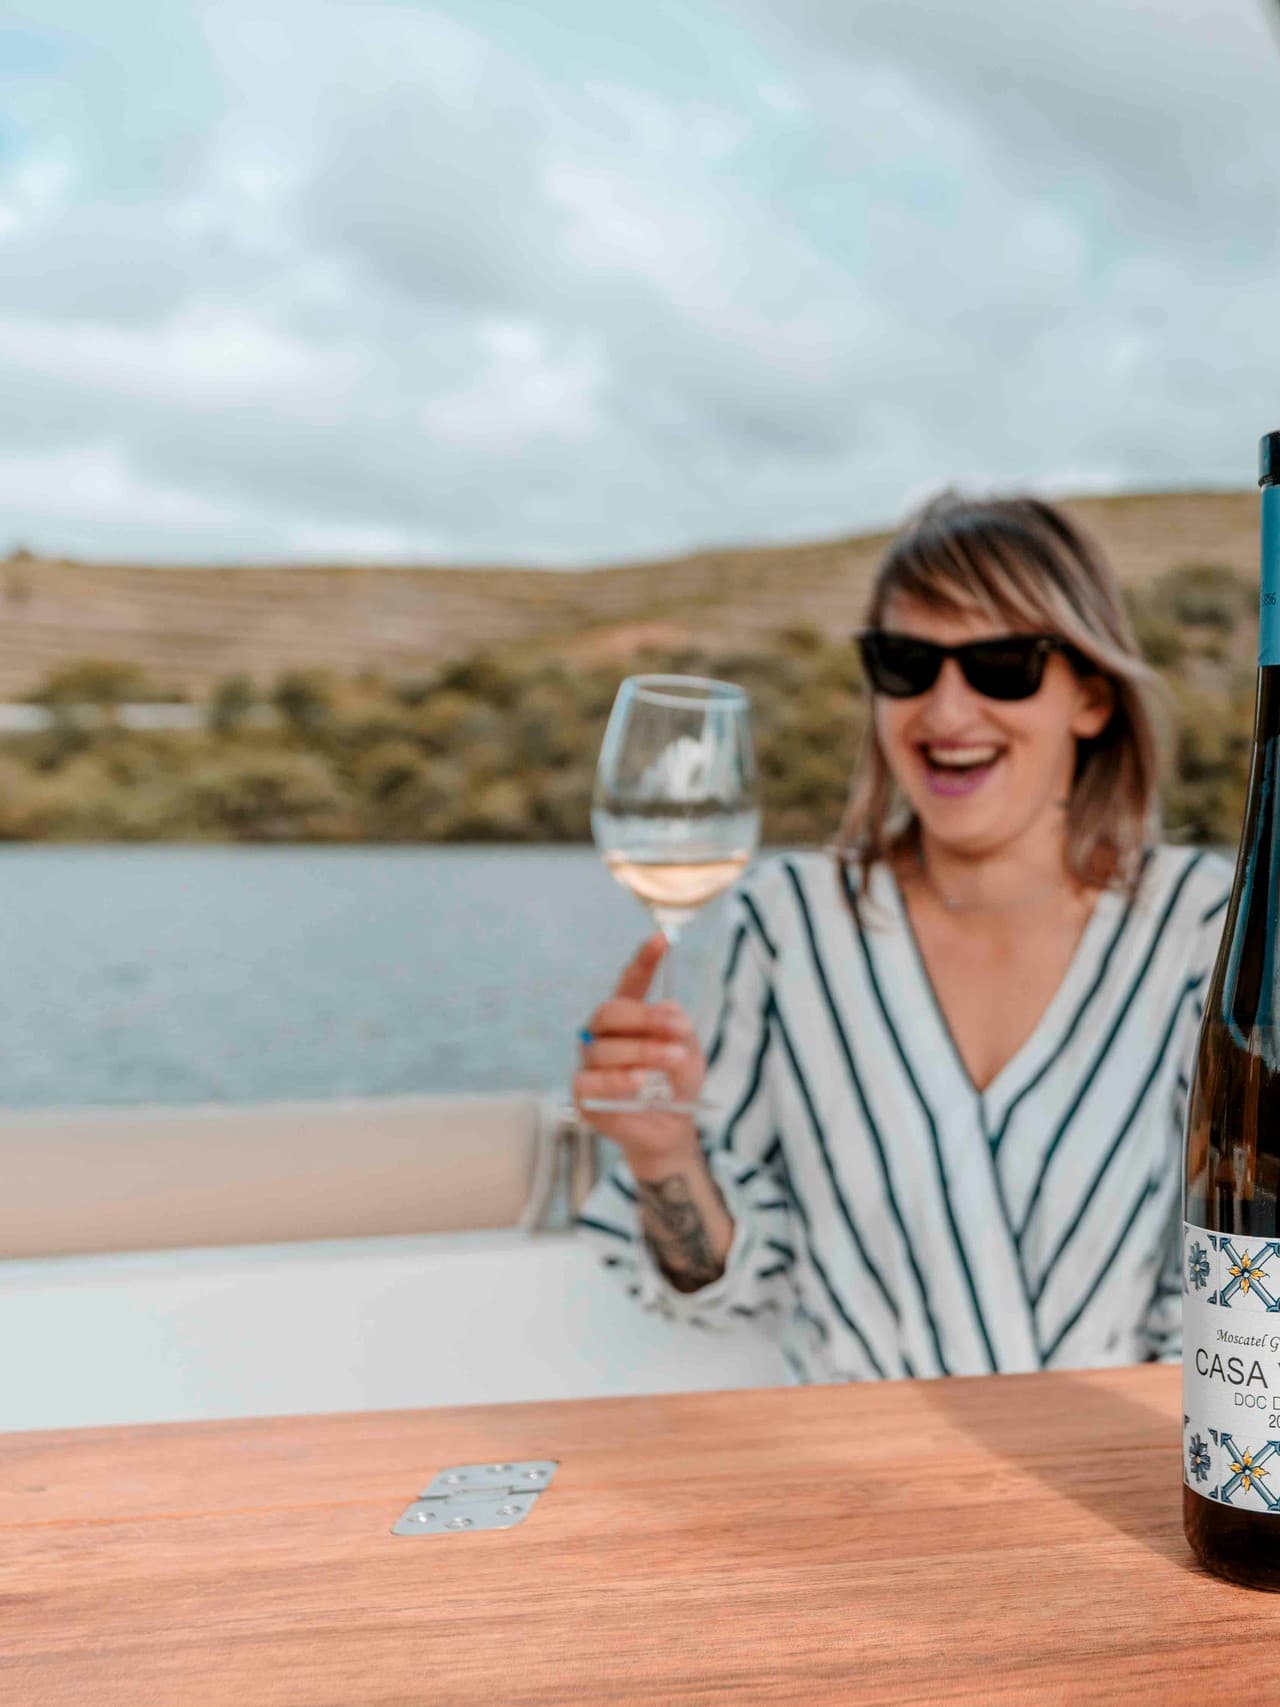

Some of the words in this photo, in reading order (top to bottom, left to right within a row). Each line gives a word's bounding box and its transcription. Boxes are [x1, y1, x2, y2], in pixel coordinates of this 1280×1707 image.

[1216, 1329, 1268, 1348] Moscatel
[1196, 1348, 1269, 1389] CASA
[1234, 1392, 1267, 1410] DOC
